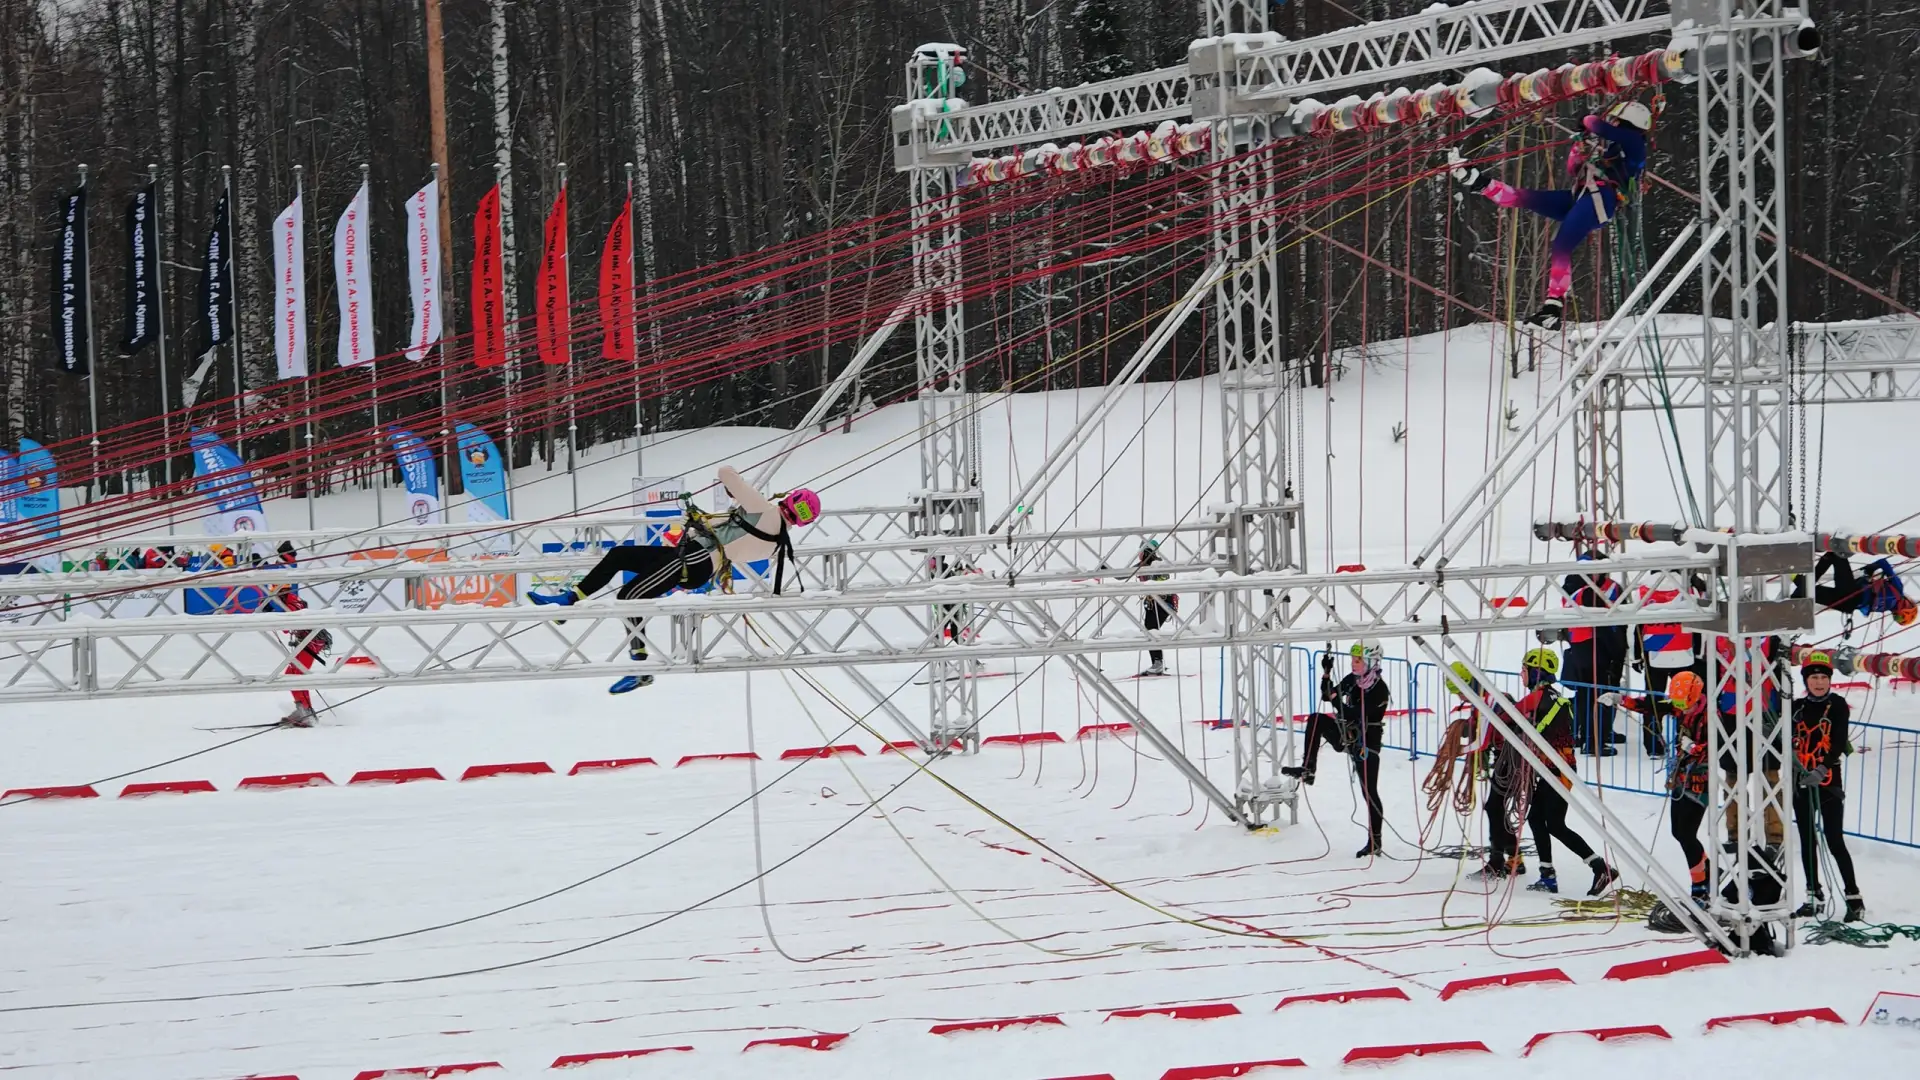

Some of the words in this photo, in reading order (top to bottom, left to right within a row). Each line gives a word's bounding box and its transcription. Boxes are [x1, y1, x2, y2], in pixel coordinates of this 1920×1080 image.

[63, 225, 74, 260] «СОЛК
[134, 223, 145, 258] «СОЛК
[346, 224, 355, 256] «СОЛК
[419, 222, 429, 255] «СОЛК
[135, 260, 143, 278] им.
[346, 259, 354, 275] им.
[420, 259, 428, 275] им.
[547, 255, 555, 272] им.
[612, 255, 620, 270] им.
[63, 263, 72, 281] им.
[210, 262, 219, 280] им.
[348, 289, 357, 299] А.
[423, 288, 431, 297] А.
[484, 288, 493, 298] А.
[548, 284, 556, 294] А.
[613, 283, 621, 293] А.
[63, 293, 74, 304] А.
[136, 291, 145, 302] А.
[209, 292, 220, 302] А.
[286, 298, 294, 308] А.
[62, 307, 76, 369] Кулаковой»
[349, 302, 361, 360] Кулаковой»
[1887, 541, 1898, 554] 8
[1891, 658, 1900, 673] 8
